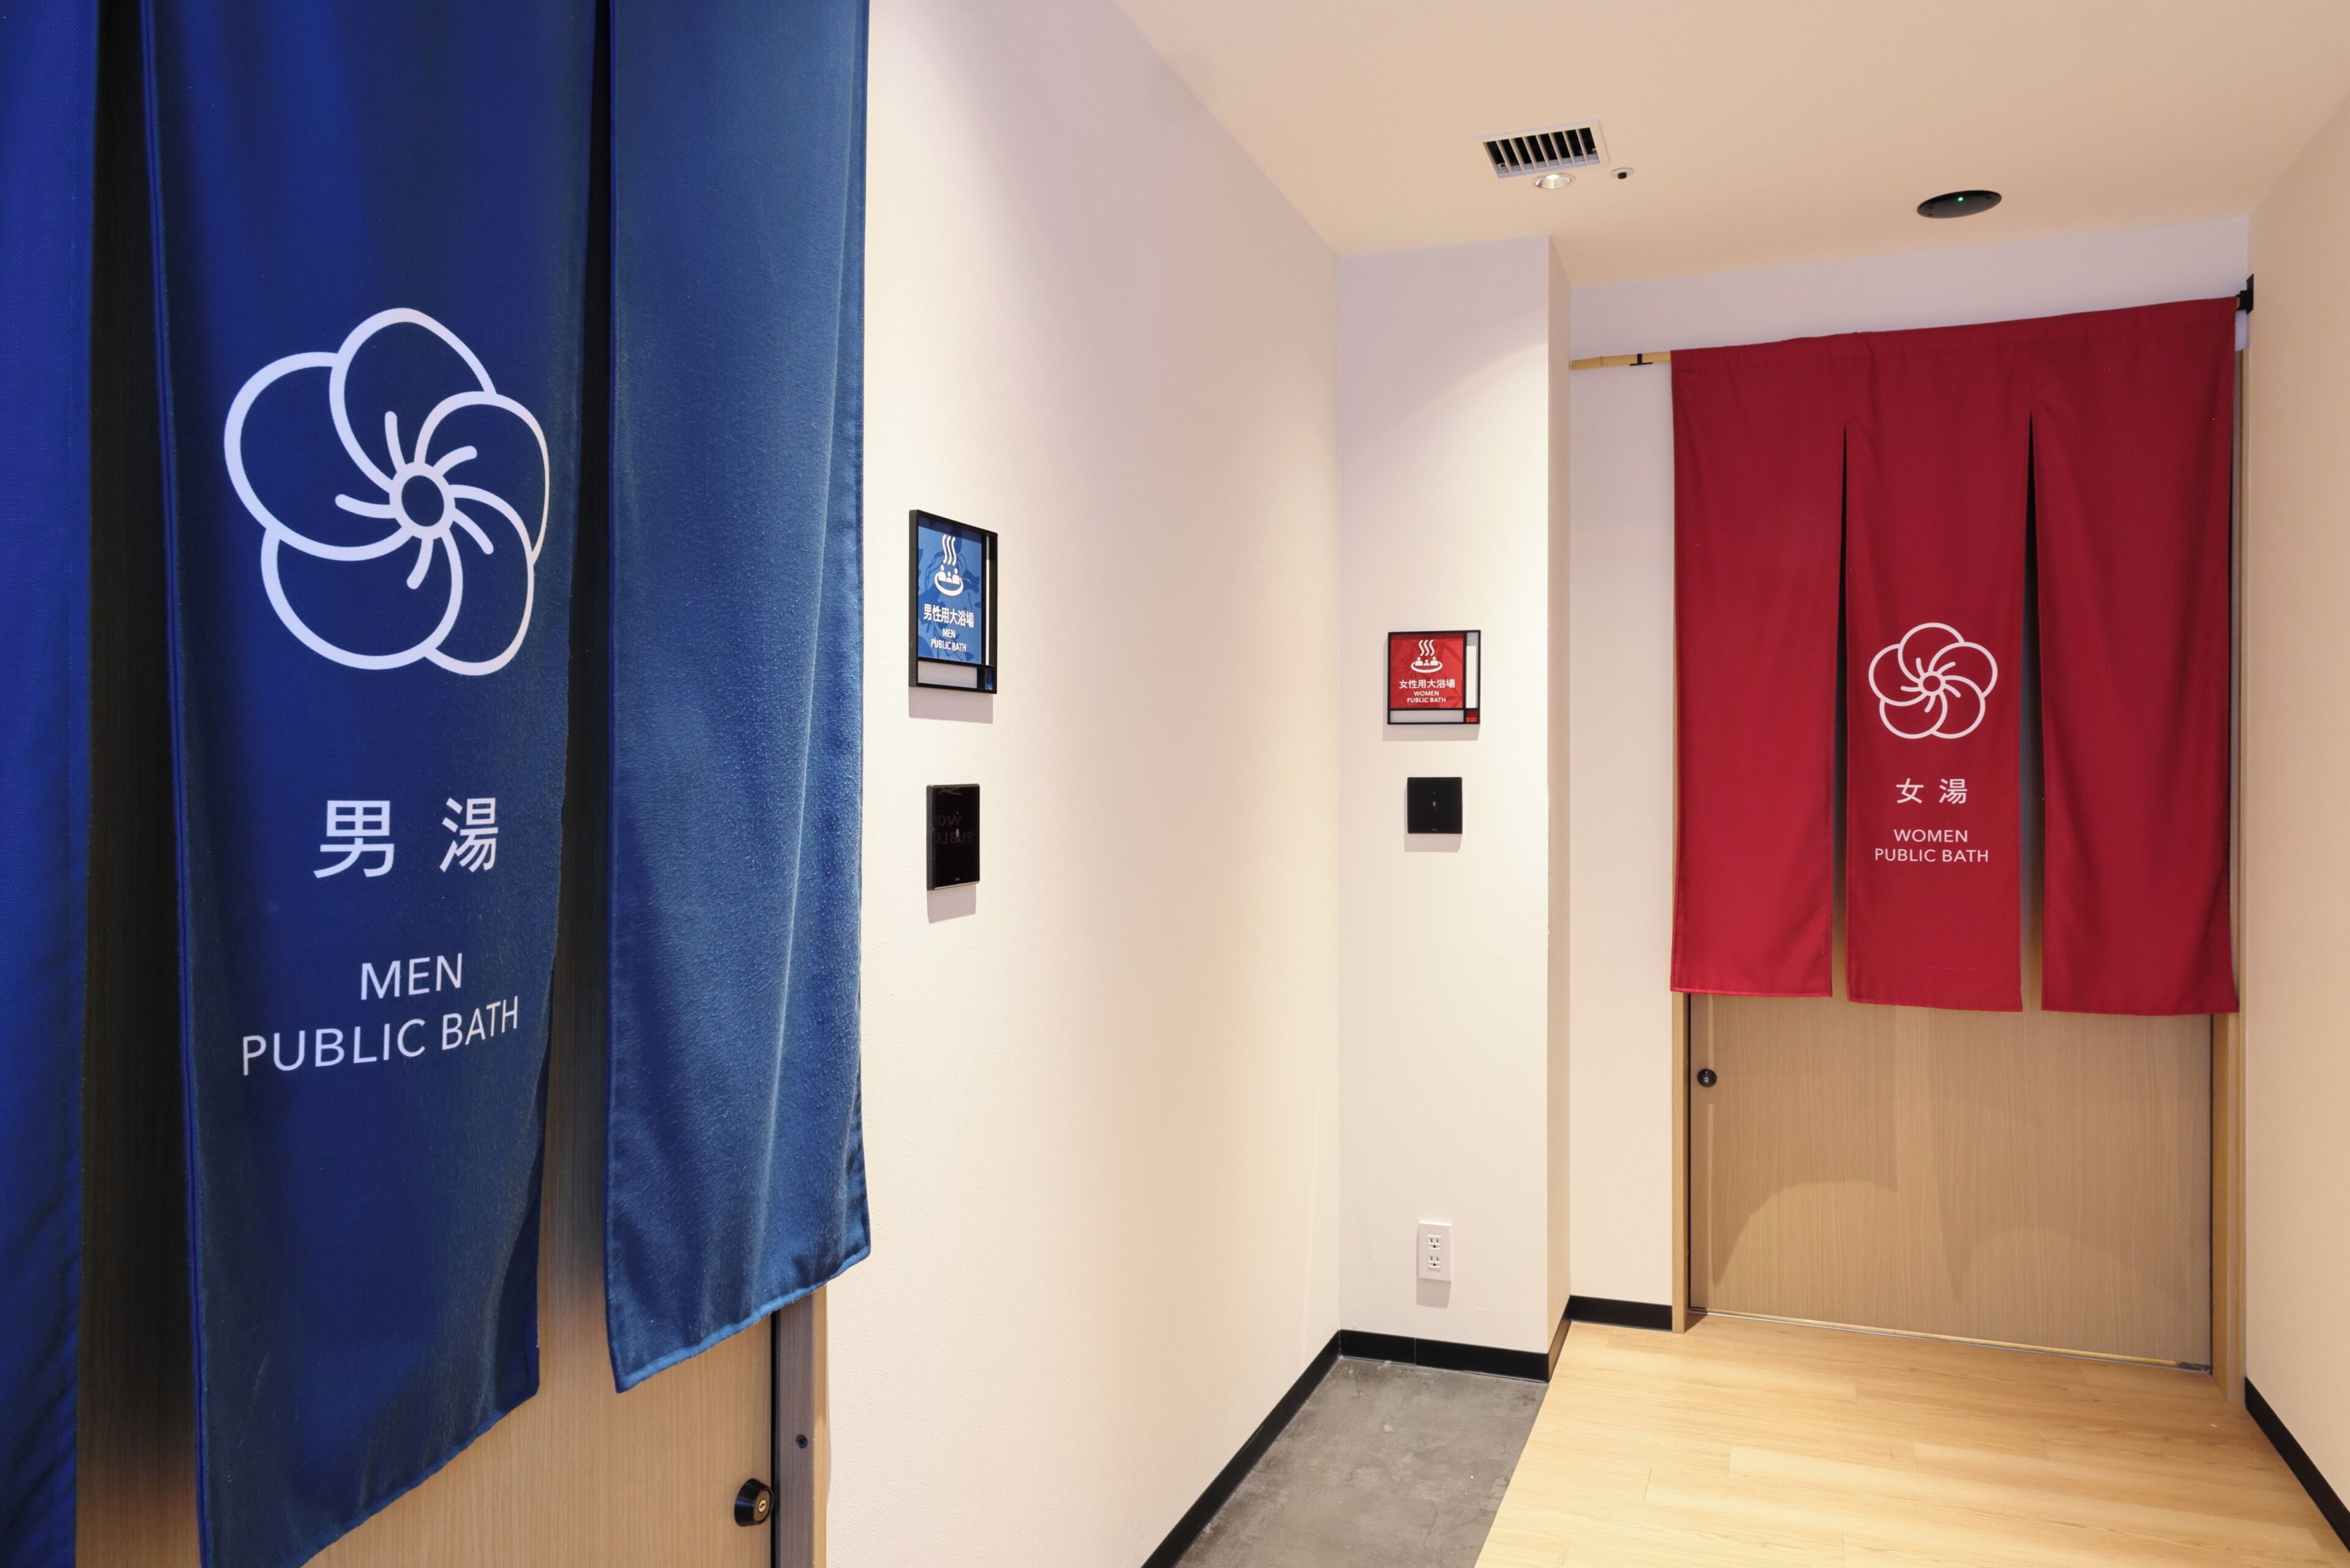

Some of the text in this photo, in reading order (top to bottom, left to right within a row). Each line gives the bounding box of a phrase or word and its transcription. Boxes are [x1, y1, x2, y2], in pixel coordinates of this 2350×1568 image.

[923, 603, 974, 628] 男性用大浴場
[942, 628, 955, 638] MEN
[931, 638, 966, 652] PUBLIC BATH
[1399, 679, 1455, 689] 女性用大浴場
[1893, 829, 1968, 842] WOMEN
[1875, 848, 1988, 862] PUBLIC BATH
[360, 953, 463, 1001] MEN
[243, 996, 518, 1076] PUBLIC BATH
